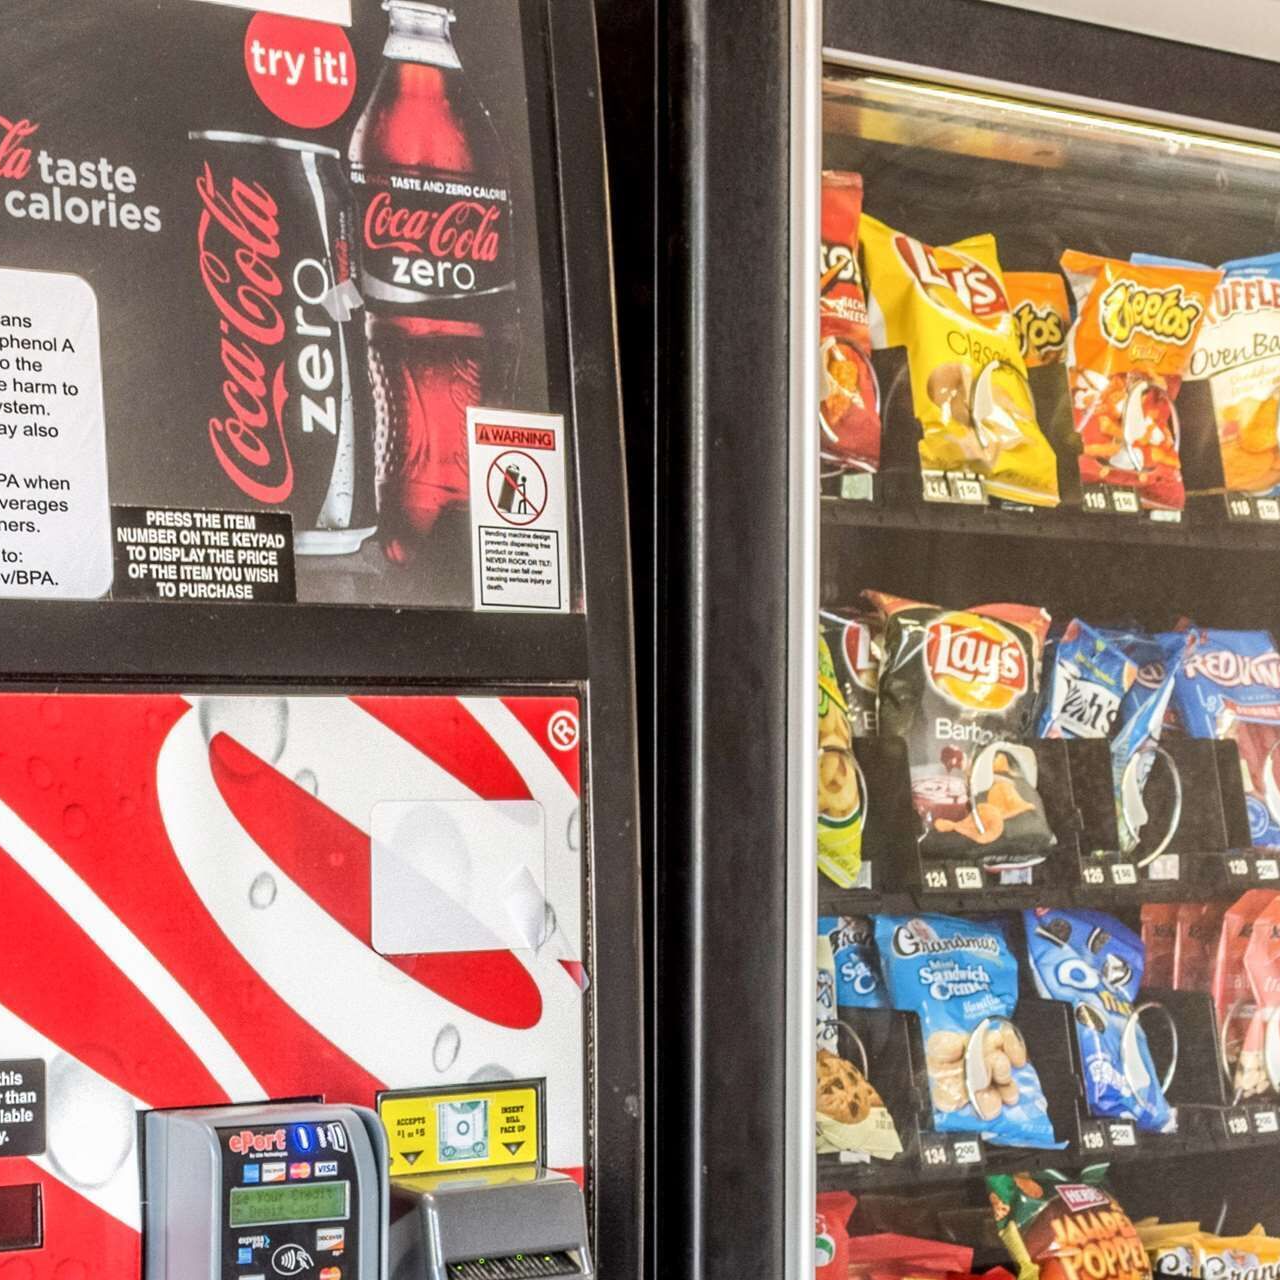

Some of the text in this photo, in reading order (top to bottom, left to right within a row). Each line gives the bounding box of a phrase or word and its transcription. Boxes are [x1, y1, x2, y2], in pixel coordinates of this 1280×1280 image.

[251, 41, 348, 85] try it!
[38, 150, 136, 193] taste
[391, 177, 471, 197] TASTE AND ZERO
[5, 187, 161, 232] calories
[364, 192, 500, 261] Coca-Cola
[392, 257, 475, 290] zero
[196, 161, 293, 503] Coca-Cola
[61, 338, 74, 352] A
[293, 258, 337, 435] zero
[1190, 348, 1249, 375] Oven
[492, 429, 551, 446] WARNING
[146, 510, 255, 530] PRESS THE ITEM
[116, 527, 285, 548] NUMBER ON THE KEYPAD
[126, 545, 278, 565] TO DISPLAY THE PRICE
[128, 563, 278, 582] OF THE ITEM YOU WISH
[156, 581, 253, 599] TO PURCHASE
[935, 625, 1020, 683] Lay's
[926, 872, 947, 887] 124
[920, 966, 990, 985] Sandwich
[4, 1089, 36, 1104] than
[397, 1117, 426, 1126] ACCEPTS
[229, 1129, 286, 1153] ePort
[925, 1149, 946, 1164] 134
[318, 1164, 336, 1173] VISA
